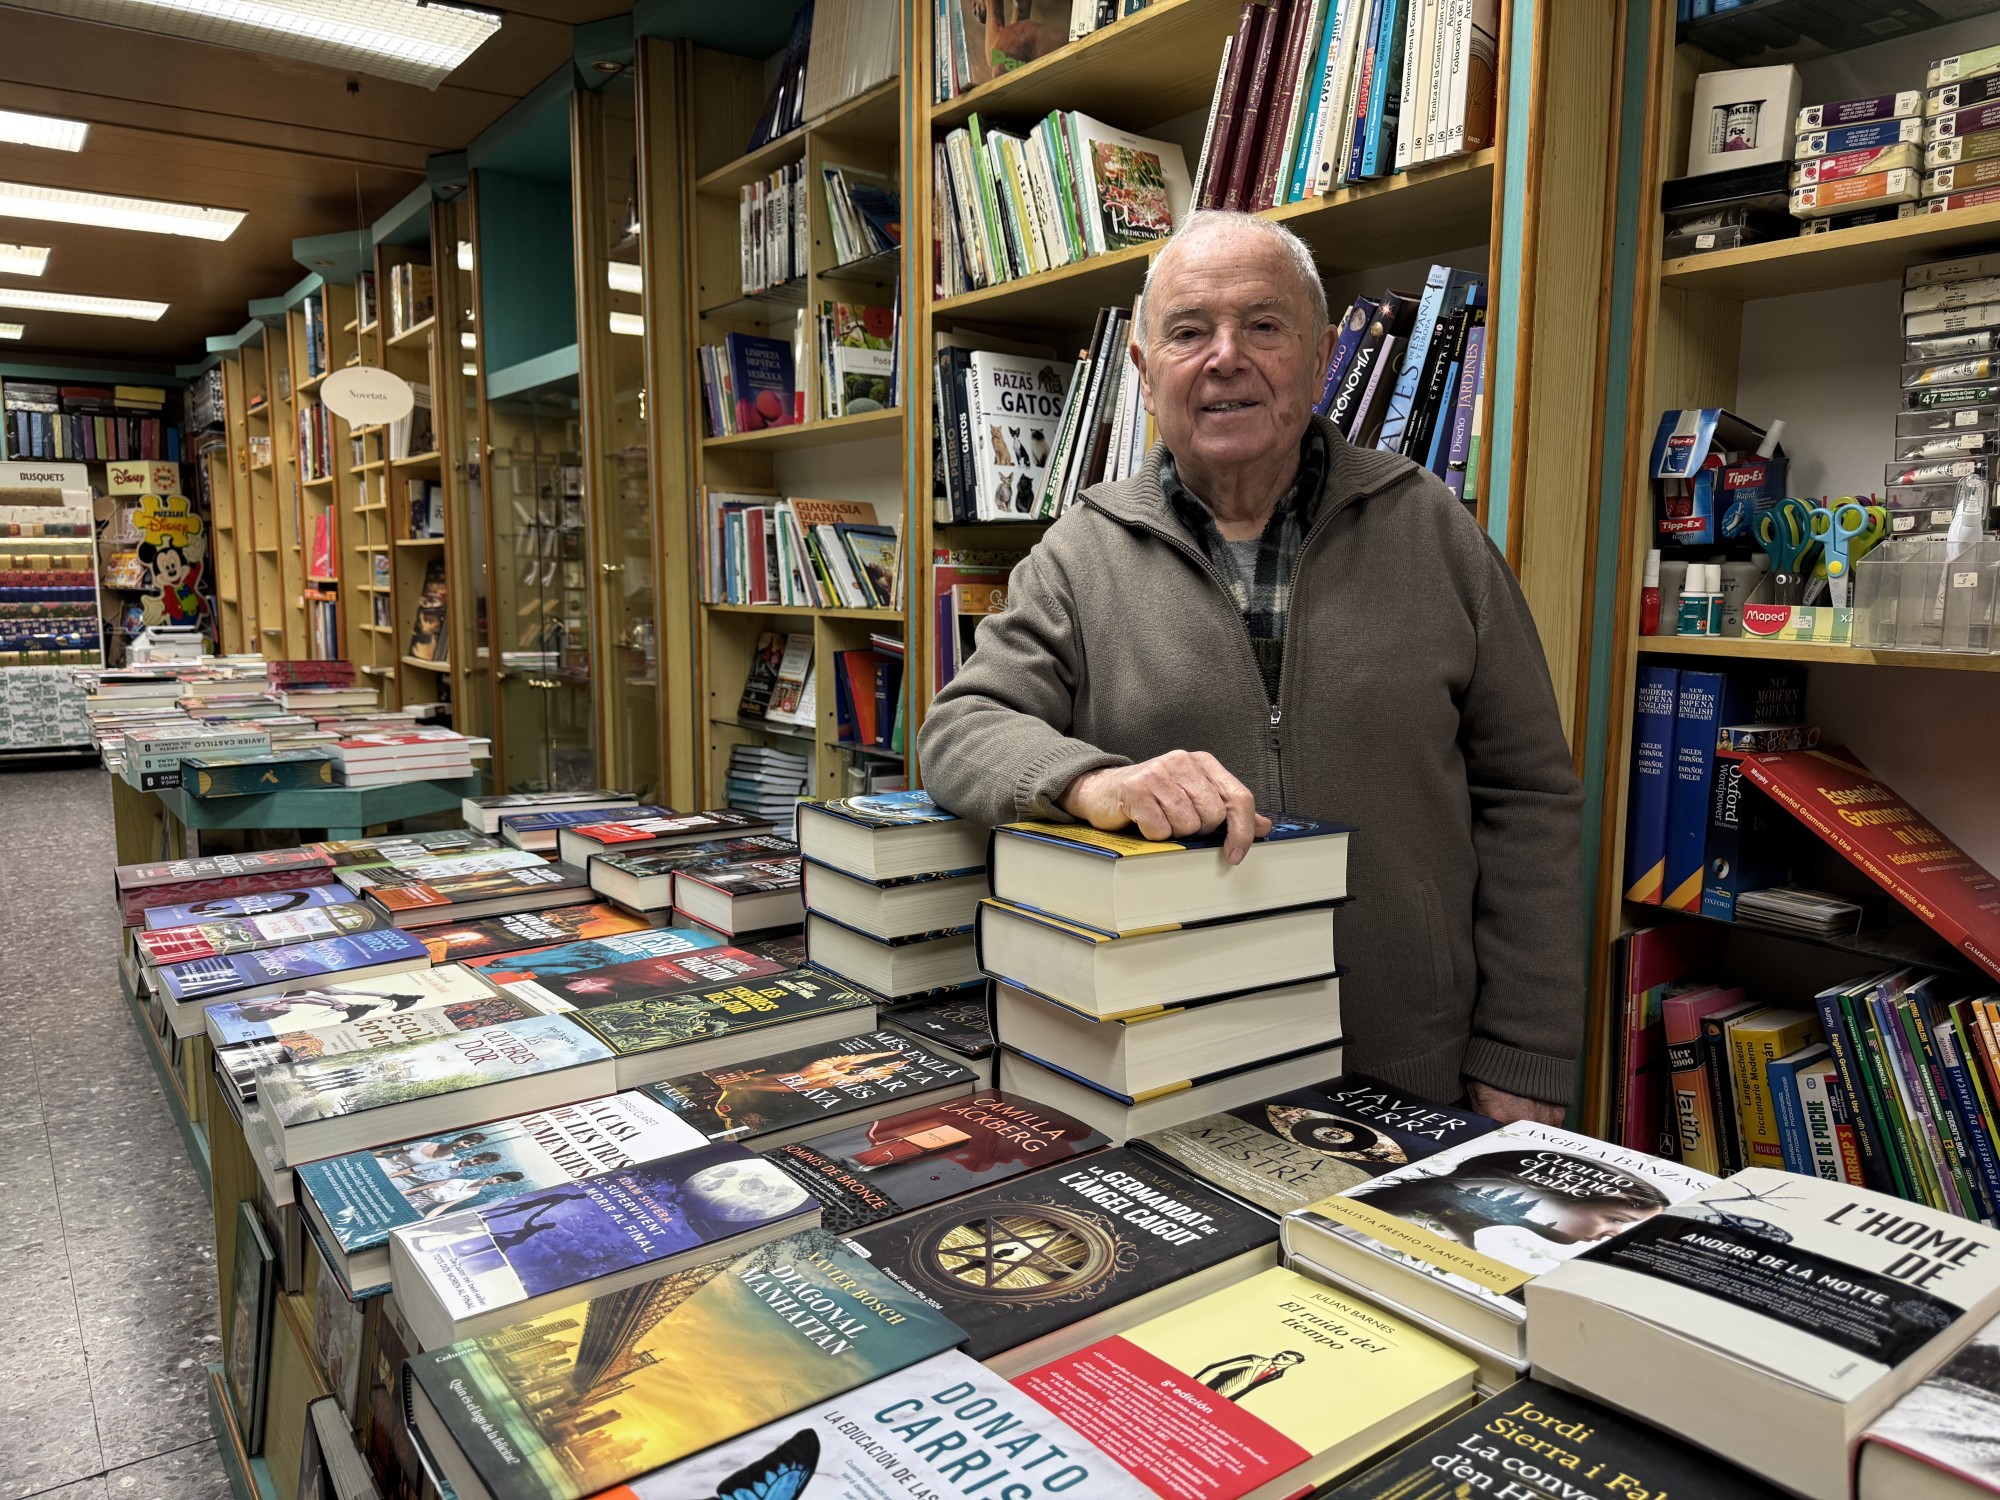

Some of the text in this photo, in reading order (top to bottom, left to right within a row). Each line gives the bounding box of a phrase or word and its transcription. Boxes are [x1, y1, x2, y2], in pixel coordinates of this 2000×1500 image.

[1296, 1, 1318, 86] MEDICINA ALTERNATIVA
[1452, 19, 1463, 75] Colocación
[1943, 57, 1959, 66] TITAN
[1321, 44, 1337, 103] ME PASA?
[1402, 50, 1414, 103] Pavimentos
[1429, 17, 1446, 123] Técnica Construcción
[1943, 86, 1959, 95] TITAN
[1089, 360, 1103, 393] VIDRIO
[1327, 344, 1347, 381] CIELO
[1380, 295, 1433, 453] AVES ESPAÑA
[349, 390, 388, 400] Novetats
[993, 373, 1033, 390] RAZAS
[1359, 374, 1379, 418] CRISTALES
[1452, 342, 1479, 454] Diseño JARDINES
[1922, 393, 1938, 404] 47
[1000, 392, 1063, 417] GATOS
[959, 412, 969, 453] GATOS
[1668, 436, 1695, 446] Tipp-Ex
[947, 428, 959, 478] PERRO
[19, 472, 65, 482] BUSQUETS
[1727, 470, 1764, 486] Tipp-Ex
[1736, 489, 1757, 500] Rapid
[153, 510, 186, 518] PUZZLES
[795, 501, 862, 515] GIMNASIA
[799, 512, 846, 524] DIARIA
[1661, 519, 1702, 531] Tipp-Ex
[1746, 610, 1785, 622] Maped
[1638, 695, 1672, 704] SOPENA
[1638, 702, 1672, 711] ENGLISH
[1678, 706, 1714, 715] ENGLISH
[1679, 692, 1714, 701] MODERN
[1679, 699, 1714, 708] SOPENA
[1678, 712, 1713, 720] DICTIONARY
[194, 737, 266, 747] JAVIER CASTILLO
[1638, 749, 1664, 758] ESPAÑOL
[1678, 755, 1704, 764] ESPAÑOL
[1638, 760, 1664, 768] ESPAÑOL
[1678, 765, 1704, 774] ESPAÑOL
[1715, 764, 1730, 821] Wordpower
[1725, 764, 1742, 823] Oxford
[1817, 784, 1895, 805] Essential
[1837, 807, 1917, 827] Grammar
[1750, 768, 1936, 919] Murphy Essential Grammar Use respuestas versión eBook
[1704, 898, 1731, 909] OXFORD
[672, 956, 739, 982] PHAETON
[723, 986, 780, 1012] TENEBRES
[724, 1001, 753, 1015] COR
[757, 988, 789, 999] LES
[1908, 999, 1929, 1044] LIVING ENGLISH
[455, 1039, 500, 1066] D'OR
[482, 1030, 540, 1065] OLIVERES
[868, 1031, 910, 1052] MÉS
[1735, 1041, 1752, 1106] Langenscheidt
[1747, 1041, 1767, 1136] Diccionario Moderno
[1873, 1054, 1889, 1087] FUNBOOK
[662, 1088, 698, 1111] KLUNE
[777, 1074, 842, 1110] BLAVA
[834, 1079, 877, 1100] MÉS
[1830, 1032, 1874, 1158] English Grammar answers
[580, 1101, 642, 1142] LA CASA
[973, 1097, 1067, 1141] CAMILLA
[1326, 1091, 1447, 1142] SIERRA
[1350, 1086, 1467, 1130] JAVIER
[1677, 1088, 1701, 1151] latín
[1807, 1100, 1831, 1138] POCHE
[549, 1107, 636, 1169] DE LES TRES
[938, 1102, 1049, 1155] LÄCKBERG
[1952, 1068, 1995, 1186] PROGRESSIVE FRANÇAIS
[519, 1114, 599, 1179] XEMENEIES
[1191, 1128, 1318, 1186] MESTRE
[1227, 1125, 1325, 1171] EL PLA
[1755, 1143, 1782, 1155] NUEVO
[781, 1145, 888, 1210] SOMNIS DE BRONZE
[1518, 1166, 1591, 1198] hable
[1536, 1152, 1634, 1188] Cuando
[1550, 1166, 1621, 1196] viento
[1613, 1156, 1711, 1191] BANZAS
[593, 1177, 666, 1236] EL SUPERVIVENT
[616, 1177, 673, 1224] ADAM SILVERA
[1058, 1171, 1203, 1248] L'ÀNGEL CAIGUT
[1088, 1165, 1214, 1229] LA GERMANDAT
[585, 1187, 655, 1254] MORIR AL FINAL
[1824, 1202, 1990, 1268] L'HOME
[1323, 1201, 1511, 1284] FINALISTA PREMIO PLANETA 2025
[1680, 1232, 1890, 1306] ANDERS DE LA MOTTE
[1883, 1251, 1958, 1291] DE
[770, 1263, 876, 1340] DIAGONAL
[805, 1250, 907, 1327] XAVIER BOSCH
[734, 1266, 858, 1357] MANHATTAN
[1309, 1292, 1396, 1335] JULIAN BARNES
[1280, 1315, 1346, 1351] tiempo
[1298, 1305, 1389, 1355] ruido del
[435, 1346, 479, 1363] Columna
[449, 1379, 467, 1397] Quin
[1171, 1388, 1215, 1415] edición
[928, 1380, 1090, 1493] DONATO
[1503, 1400, 1595, 1444] Jordi
[824, 1411, 916, 1484] LA EDUCACIÓN DE
[1456, 1432, 1499, 1458] La
[1485, 1417, 1583, 1471] Sierra
[1431, 1452, 1495, 1490] d'en
